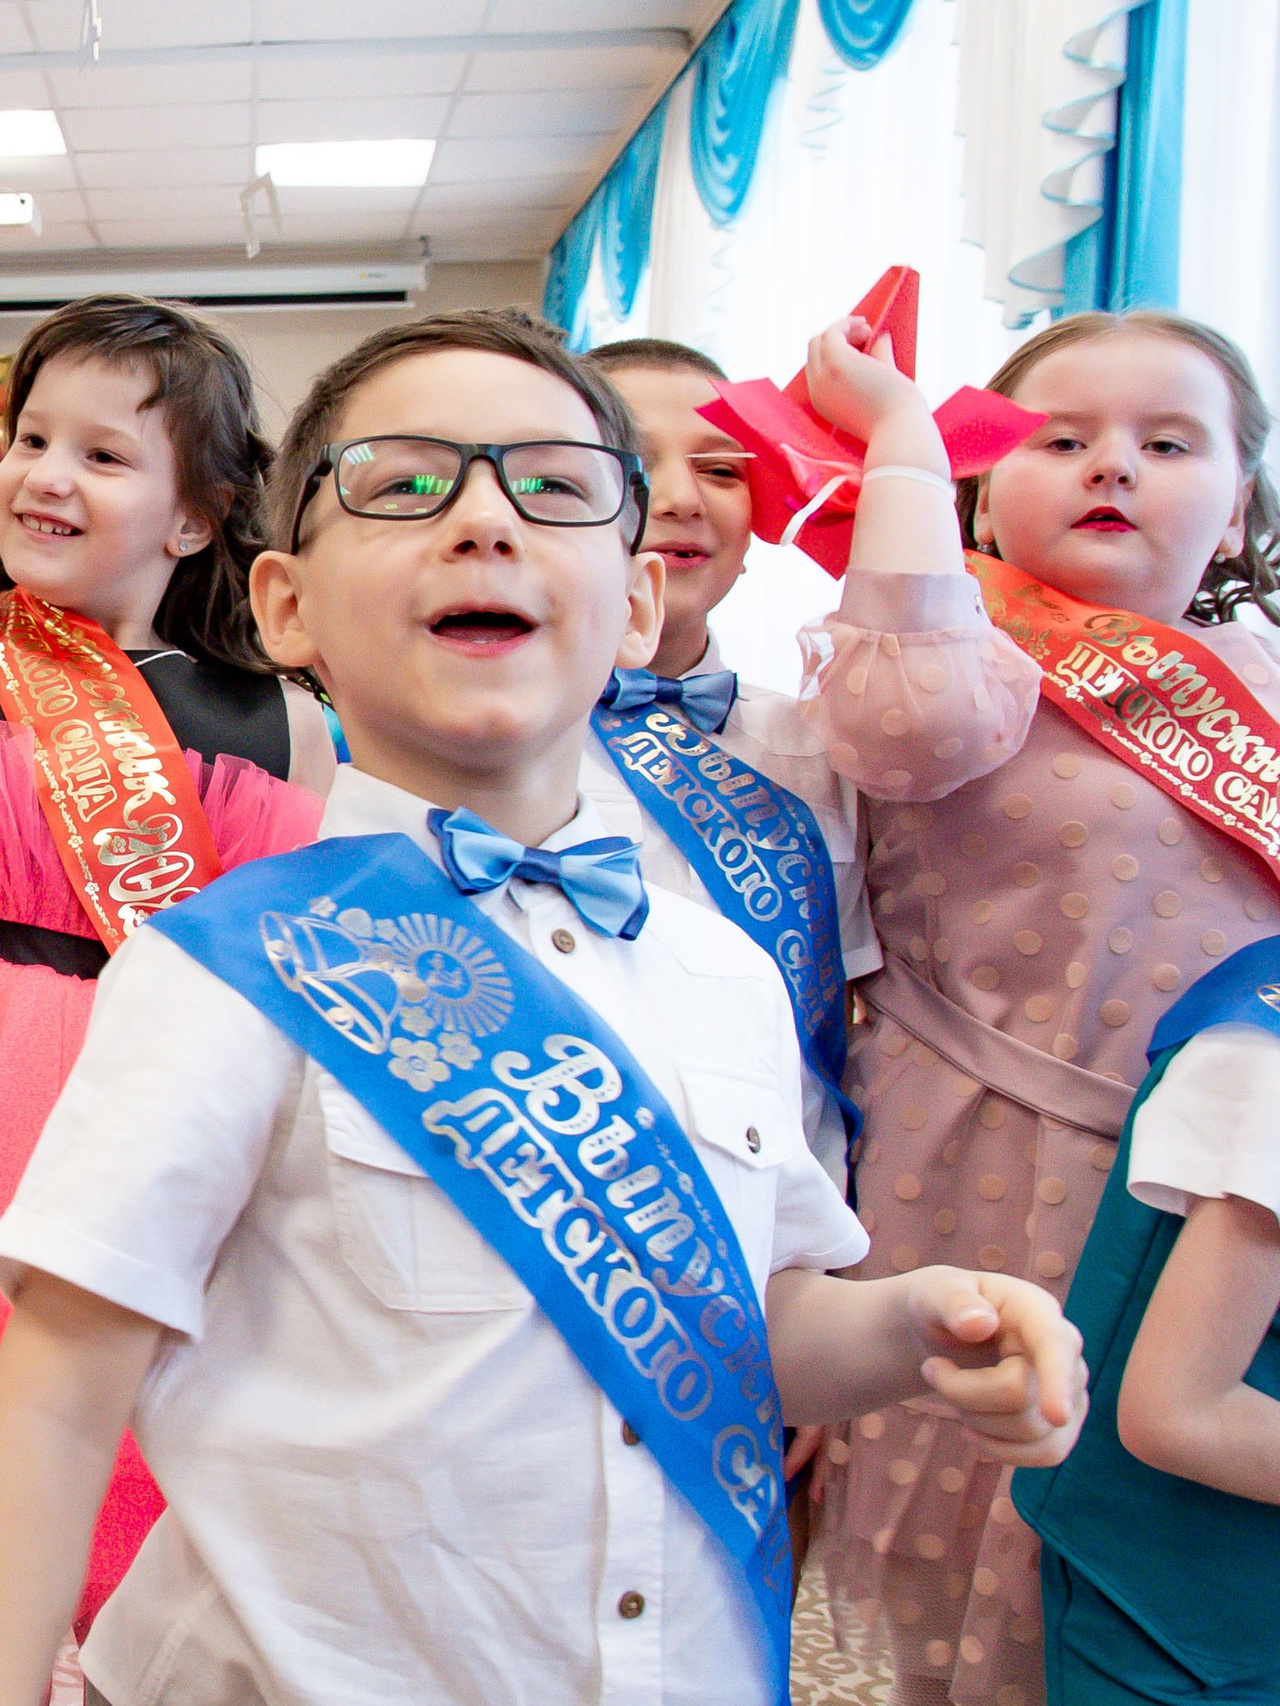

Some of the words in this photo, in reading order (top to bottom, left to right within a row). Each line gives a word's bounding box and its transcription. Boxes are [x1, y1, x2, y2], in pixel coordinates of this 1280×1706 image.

[51, 719, 118, 822] САДА
[1056, 641, 1213, 781] ДЕТСКОГО
[607, 731, 782, 922] ДЕТСКОГО
[421, 1087, 713, 1422] ДЕТСКОГО
